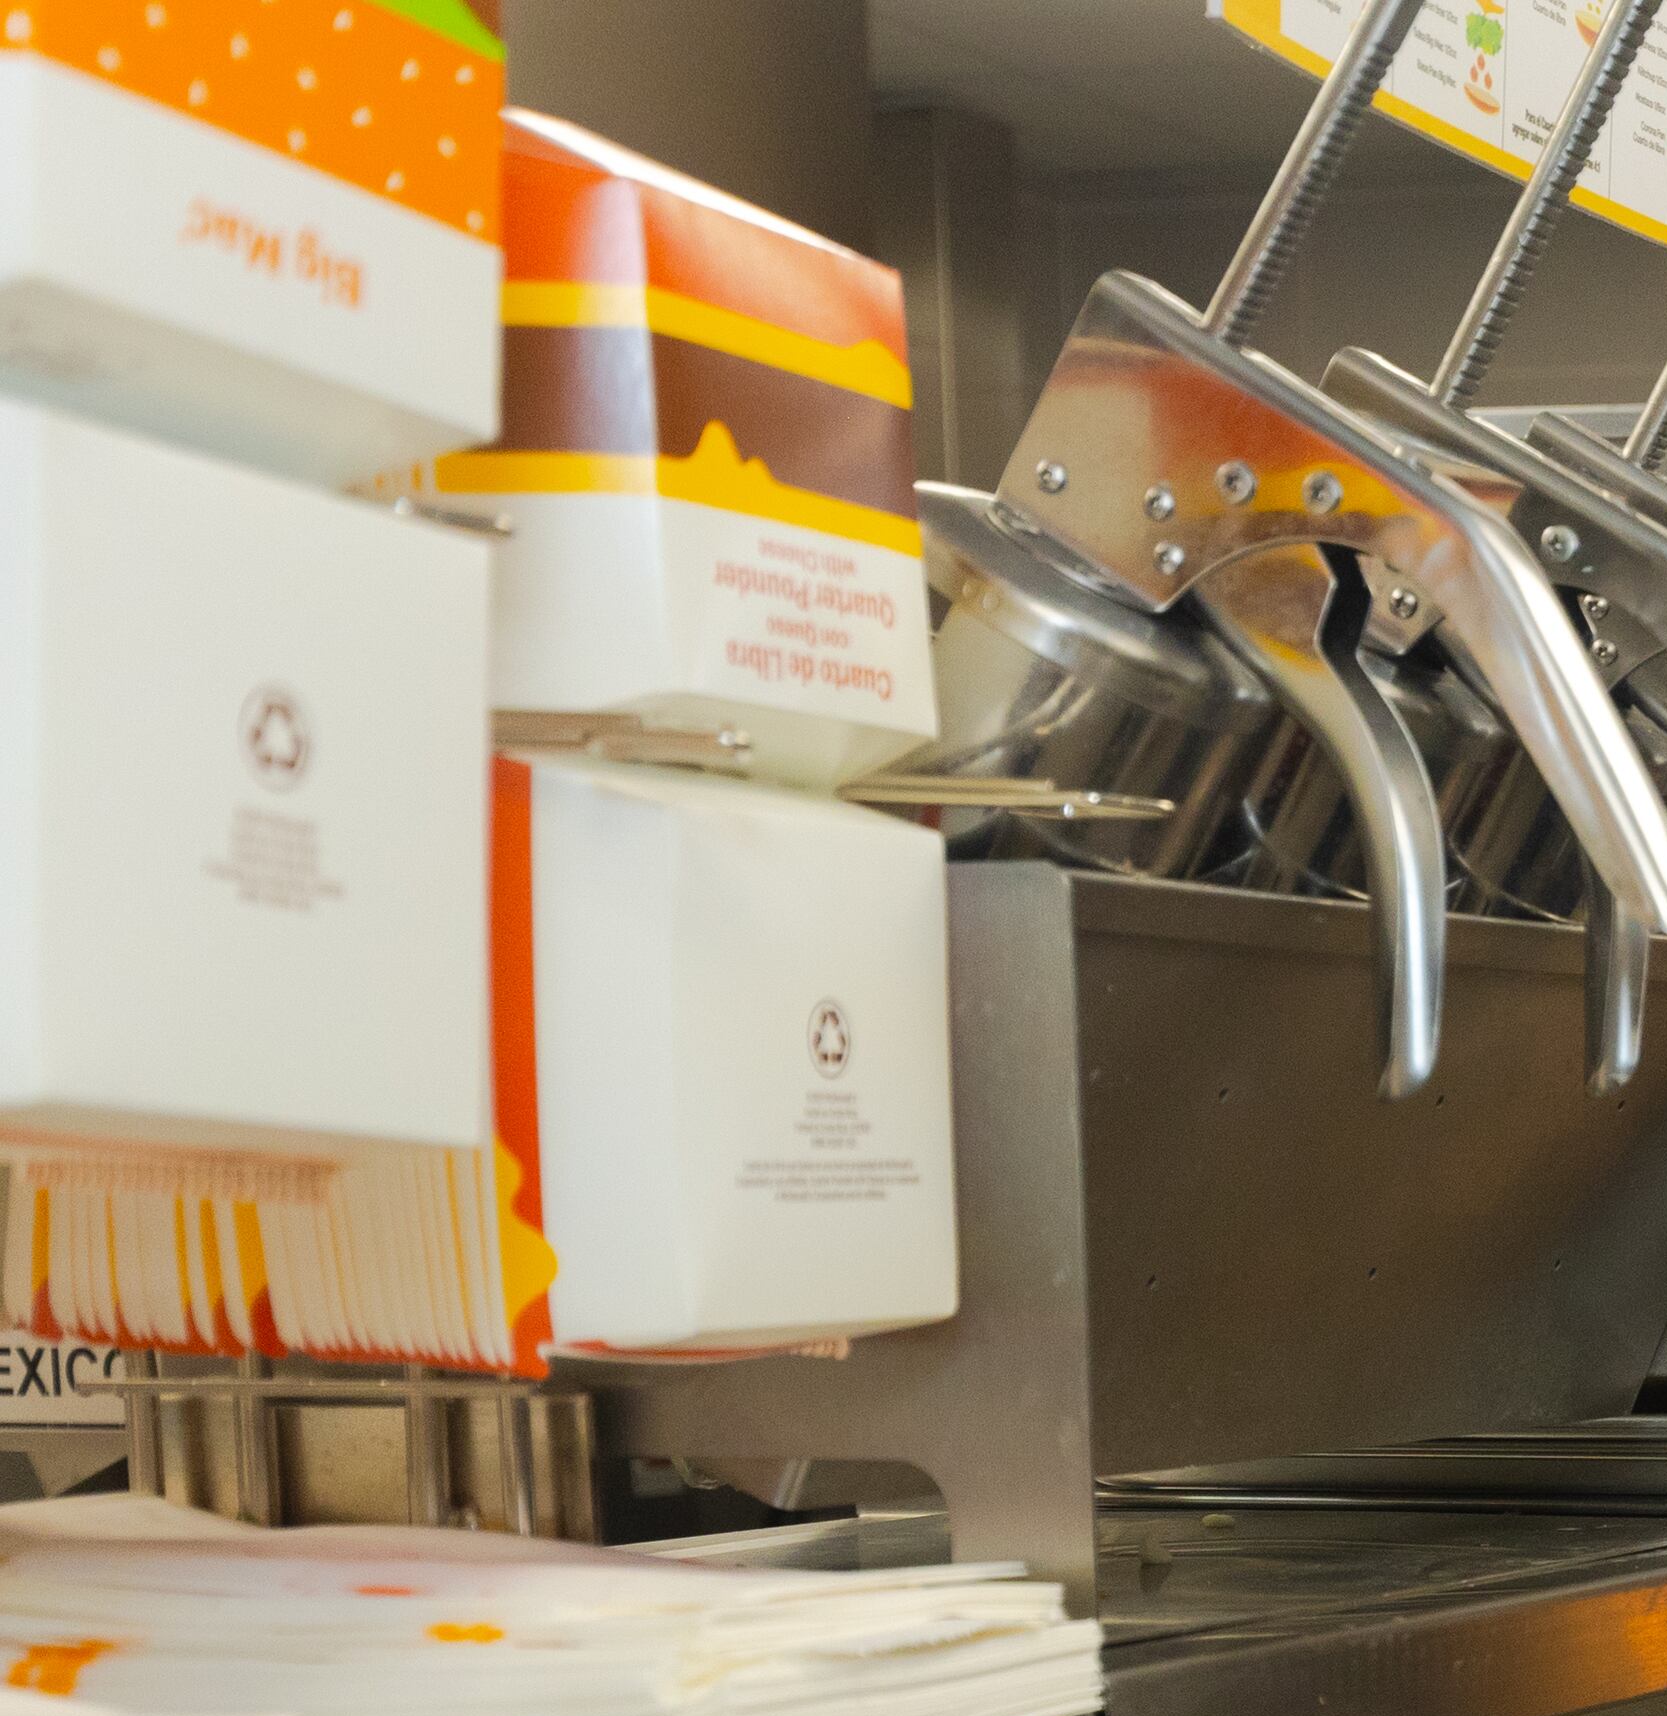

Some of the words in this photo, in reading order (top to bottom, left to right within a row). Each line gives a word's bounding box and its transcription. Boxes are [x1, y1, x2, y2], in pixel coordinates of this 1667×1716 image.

[187, 196, 281, 276] Mac
[297, 229, 362, 310] Big
[713, 561, 810, 611] Pounder
[816, 584, 895, 629] Quarter
[725, 640, 783, 681] Libra
[791, 654, 815, 686] de
[821, 660, 893, 702] Cuarto
